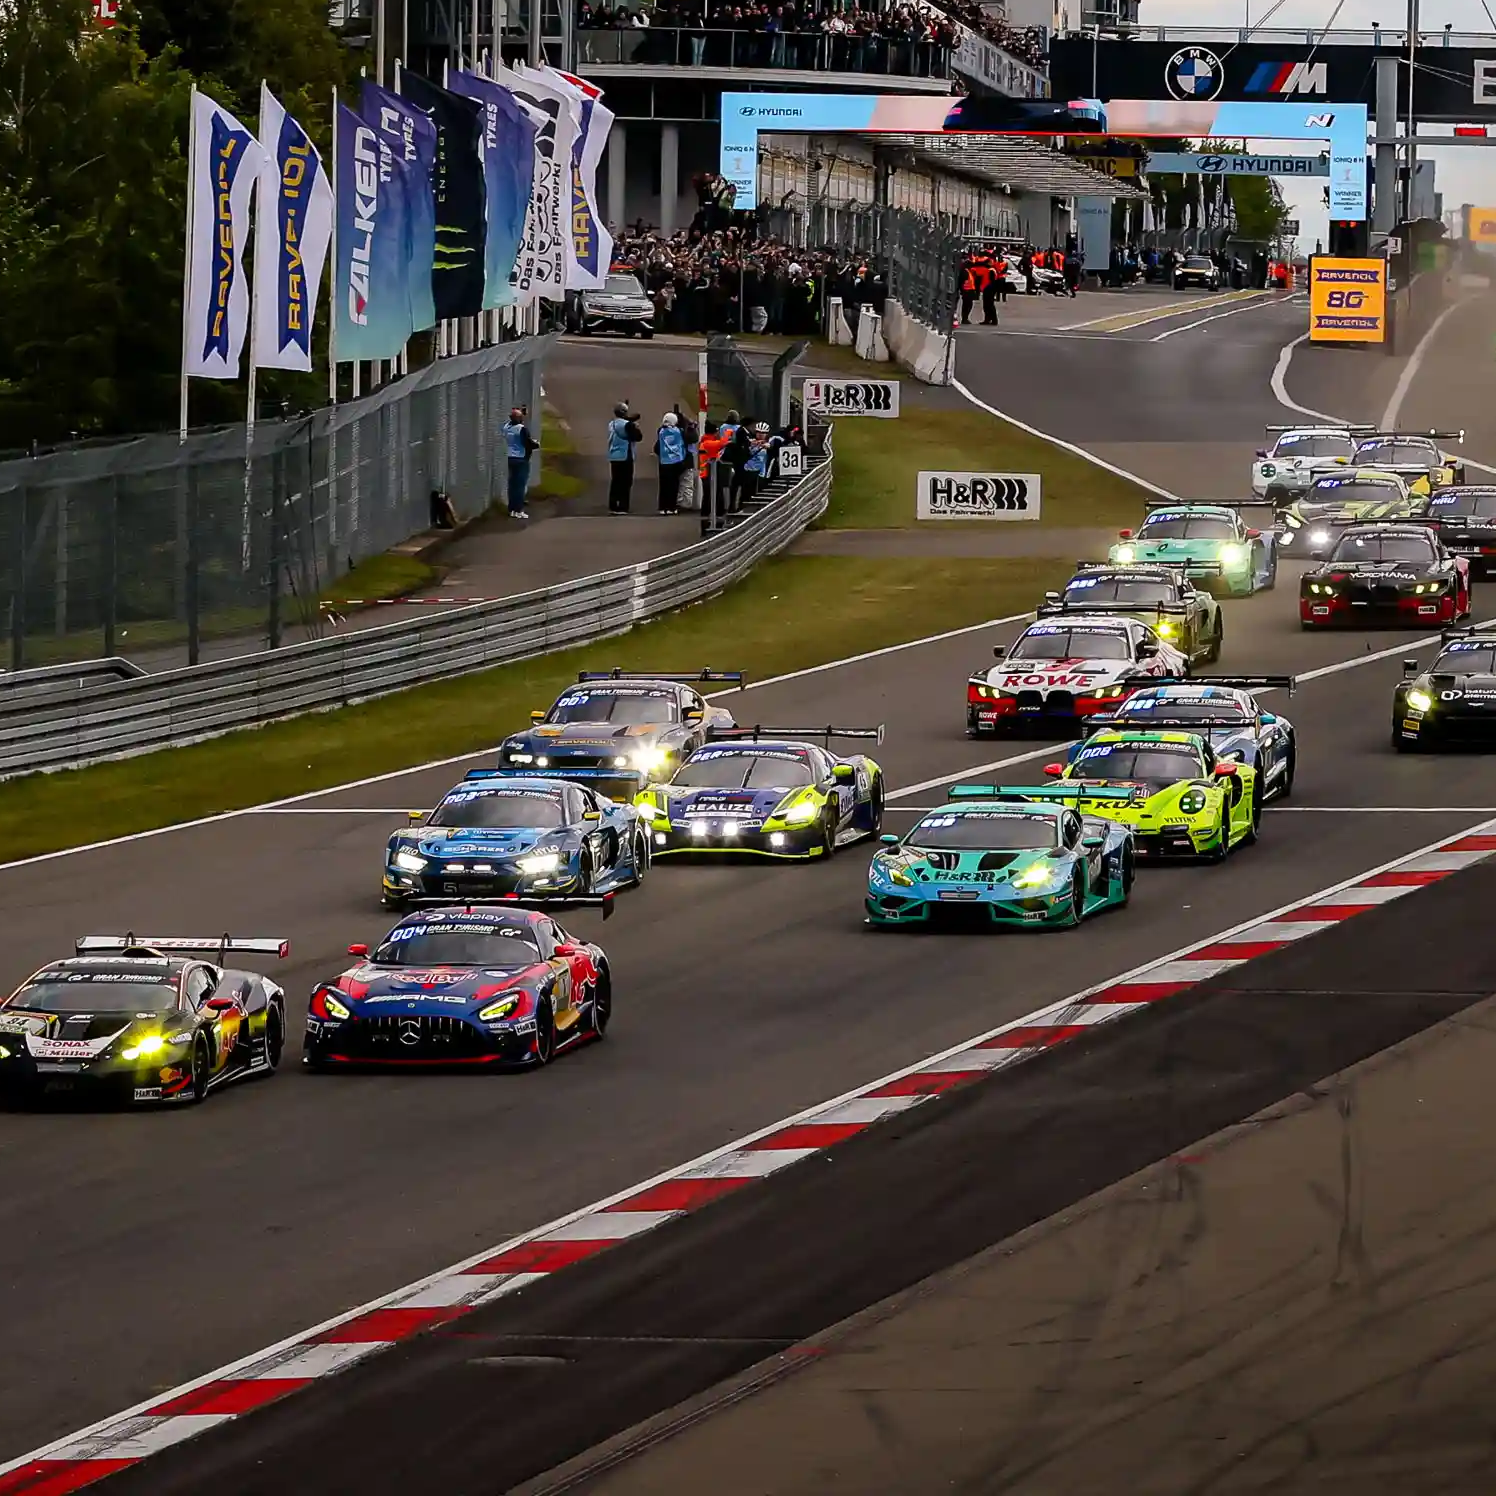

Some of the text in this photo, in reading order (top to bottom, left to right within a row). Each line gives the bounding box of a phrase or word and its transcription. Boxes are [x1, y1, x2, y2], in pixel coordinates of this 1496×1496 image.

[758, 107, 803, 117] HYUNDAI
[486, 102, 499, 149] TYRES
[438, 124, 446, 202] ENERGY
[1232, 158, 1312, 174] HYUNDAI
[348, 125, 380, 327] FALKEN
[781, 450, 799, 469] 3a
[1348, 571, 1417, 581] YOKOHAMA
[1002, 674, 1096, 688] ROWE
[685, 803, 754, 812] REALIZE
[449, 912, 505, 922] viaplay
[390, 925, 427, 942] 004
[426, 925, 452, 933] GRAN
[92, 974, 118, 982] GRAN
[41, 1039, 91, 1047] SONAX
[49, 1048, 93, 1056] Müller
